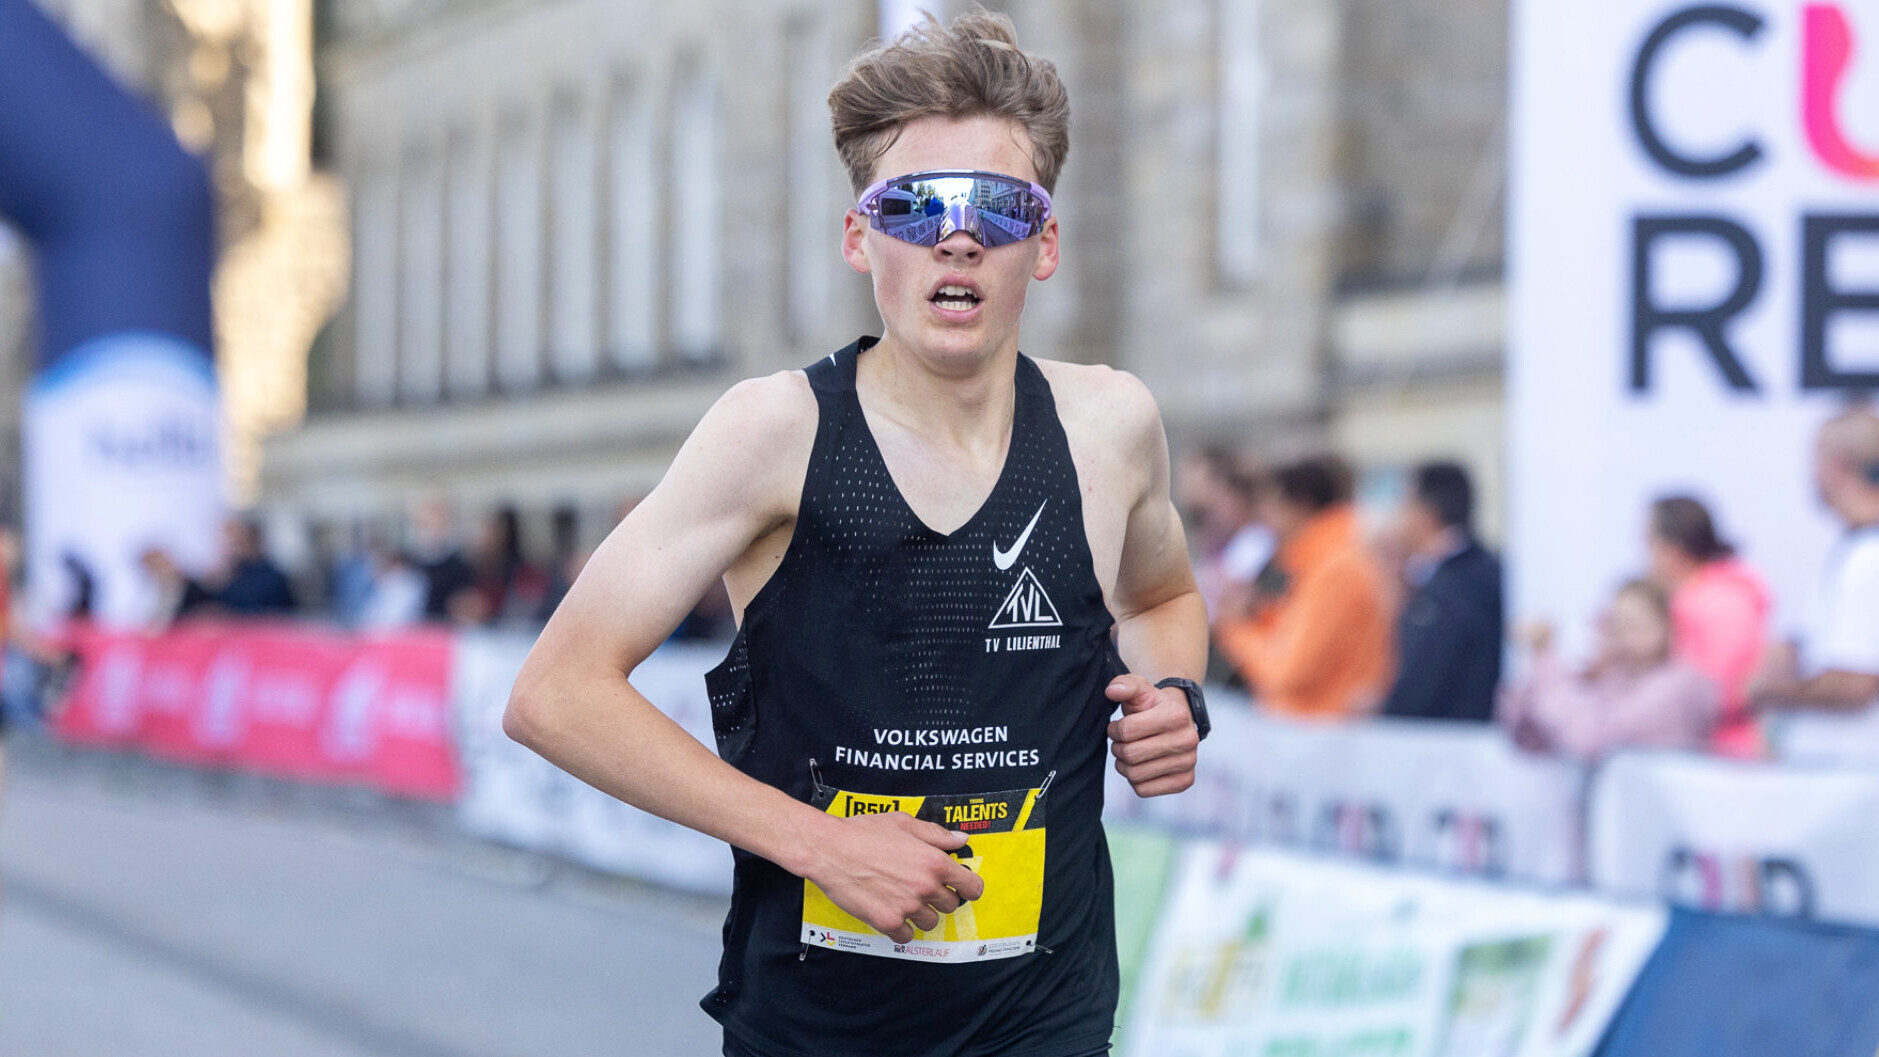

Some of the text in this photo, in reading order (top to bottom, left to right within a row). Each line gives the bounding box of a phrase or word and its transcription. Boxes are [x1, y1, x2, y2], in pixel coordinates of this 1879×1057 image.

[1632, 215, 1879, 391] RE
[1006, 583, 1054, 623] TVL
[985, 634, 1061, 653] TV LILIENTHAL
[873, 725, 1009, 746] VOLKSWAGEN
[835, 746, 1040, 771] FINANCIAL SERVICES
[944, 802, 1008, 823] TALENTS
[960, 820, 991, 831] NEEDED!
[906, 945, 950, 958] ALSTERLAUF
